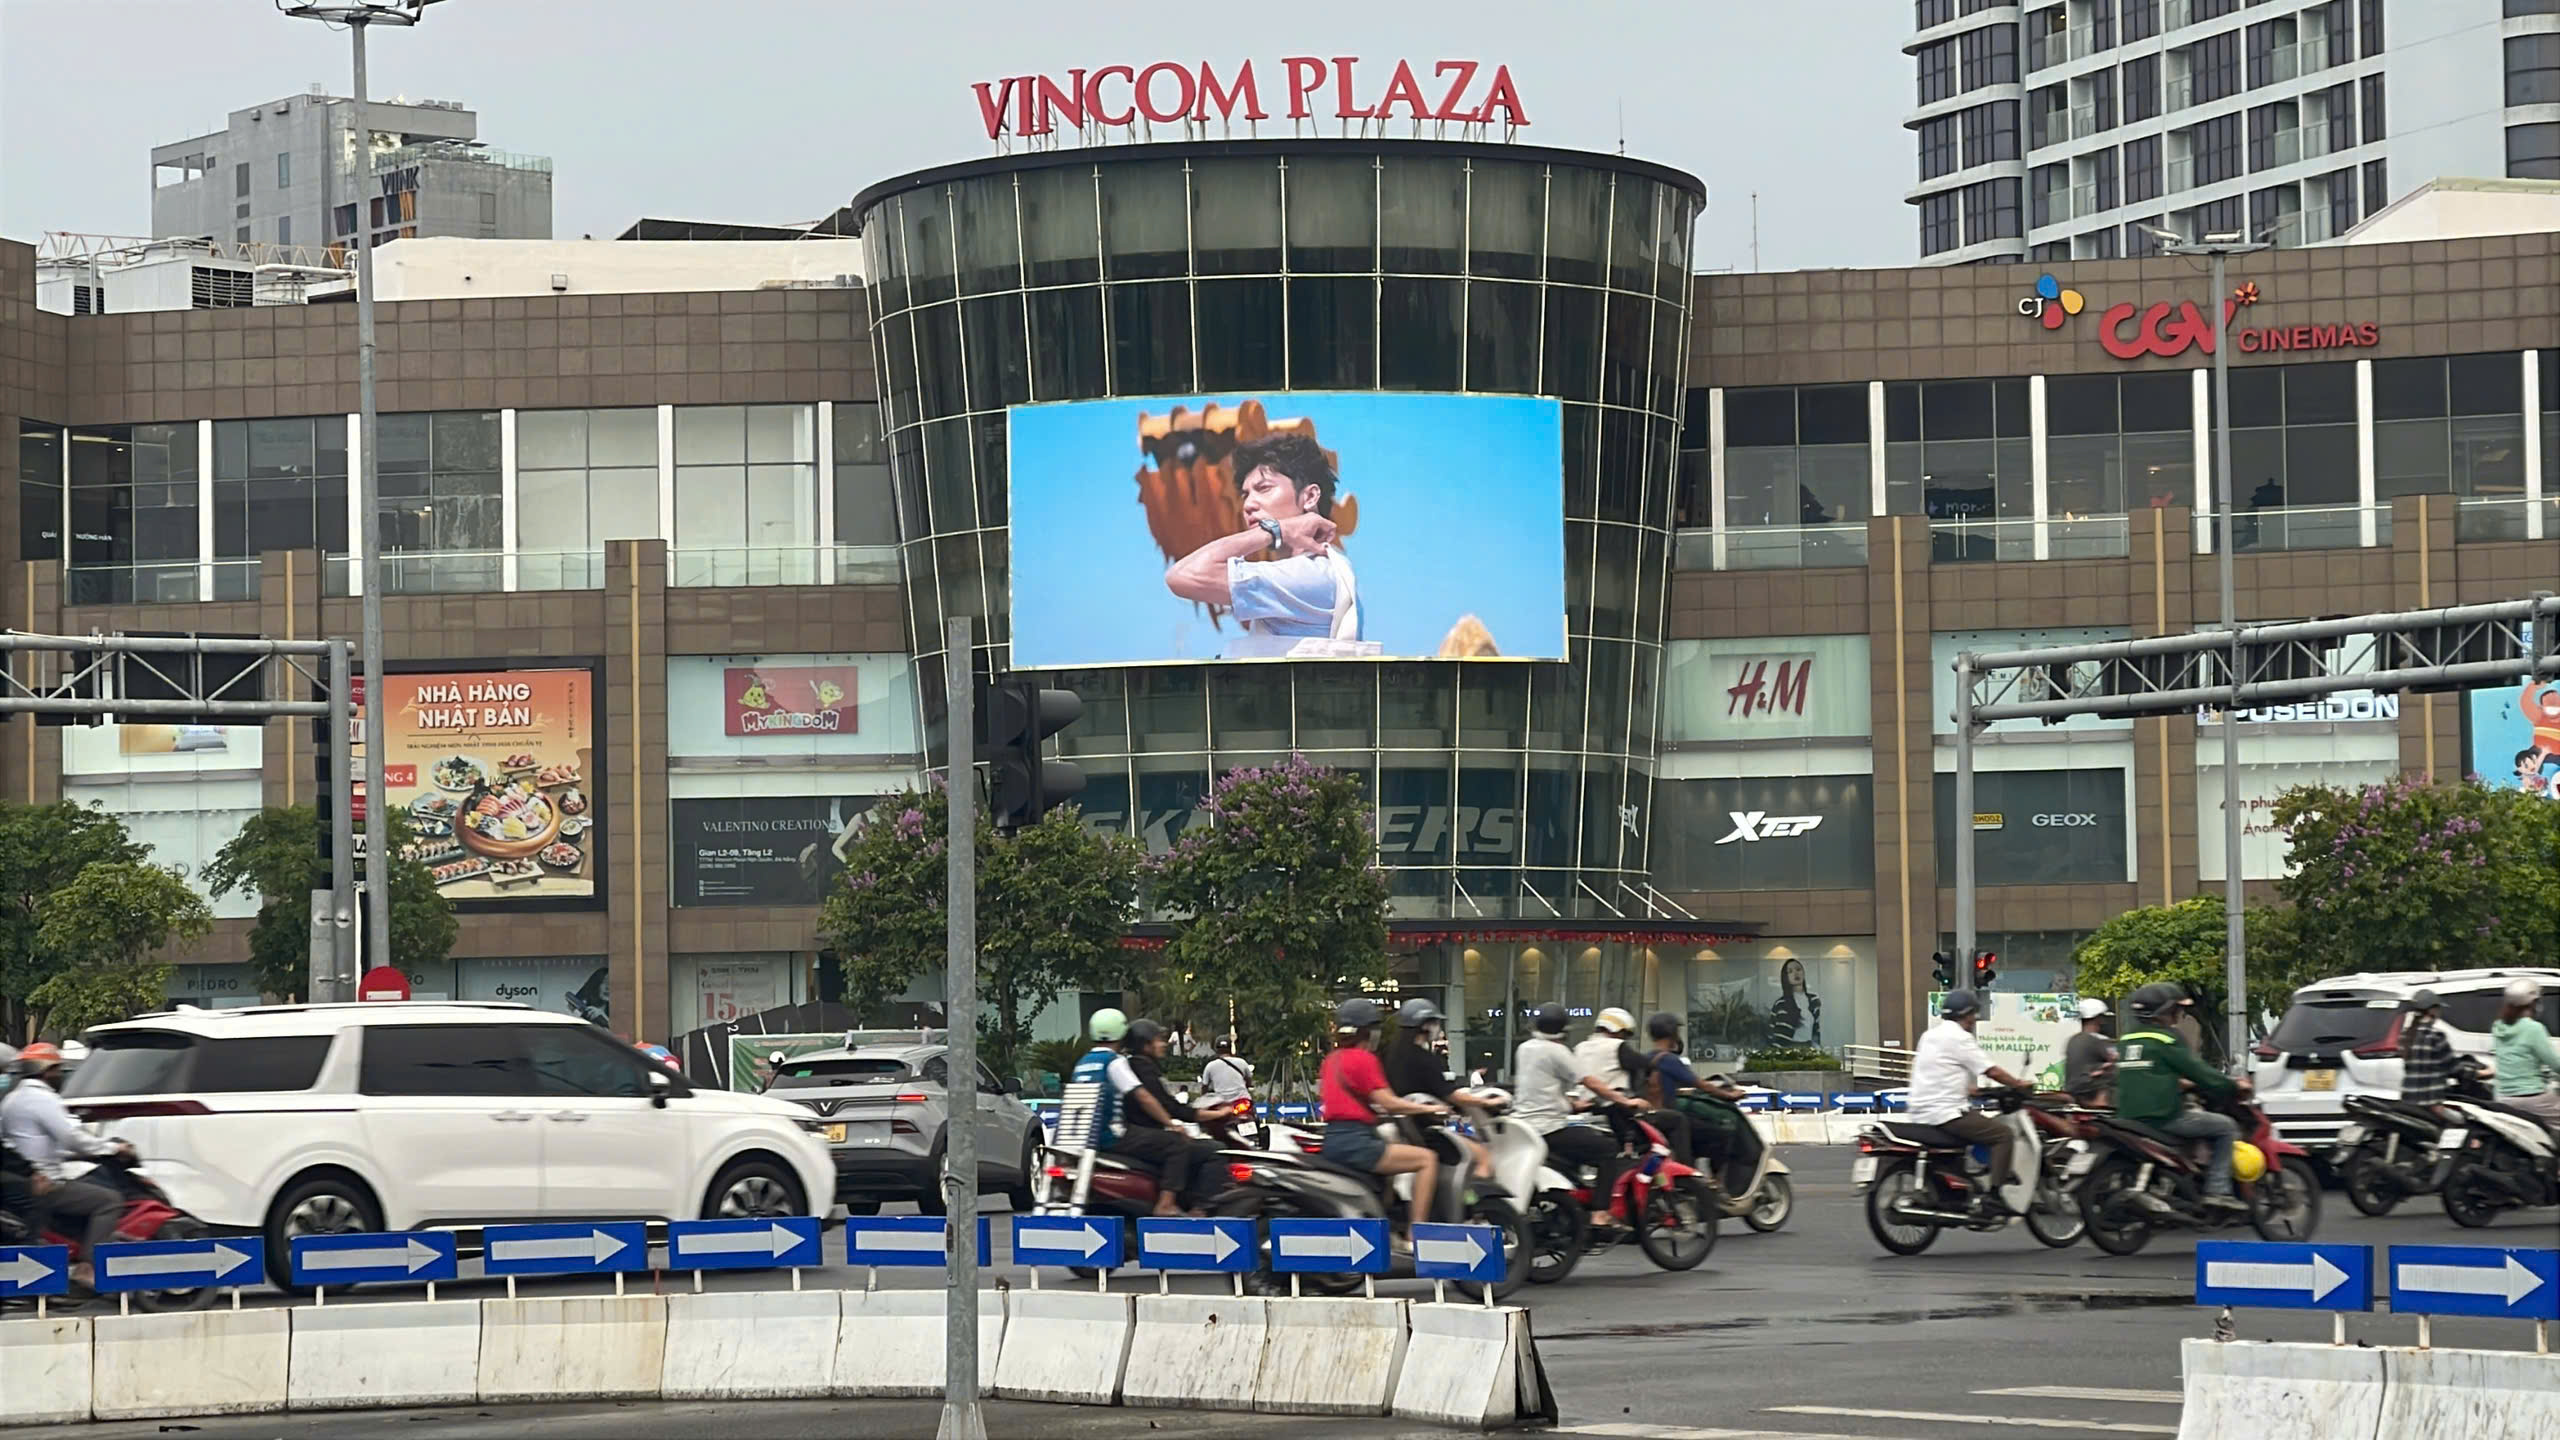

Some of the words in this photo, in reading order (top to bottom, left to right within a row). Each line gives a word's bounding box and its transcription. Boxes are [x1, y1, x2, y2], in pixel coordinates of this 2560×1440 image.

[971, 58, 1268, 140] VINCOM
[1282, 56, 1531, 126] PLAZA
[2018, 298, 2043, 318] CJ
[2238, 322, 2380, 352] CINEMAS
[417, 680, 463, 703] NHÀ
[469, 679, 531, 702] HÀNG
[1727, 659, 1812, 718] H&M
[418, 703, 479, 733] NHẬT
[484, 700, 531, 727] BẢN
[406, 772, 414, 782] 4
[703, 821, 769, 832] VALENTINO
[1714, 811, 1823, 845] XTEP
[2032, 813, 2097, 827] GEOX
[187, 978, 239, 992] PEDRO
[496, 984, 538, 1000] dyson
[704, 992, 736, 1020] 15
[1996, 1043, 2051, 1053] MALLIDAY
